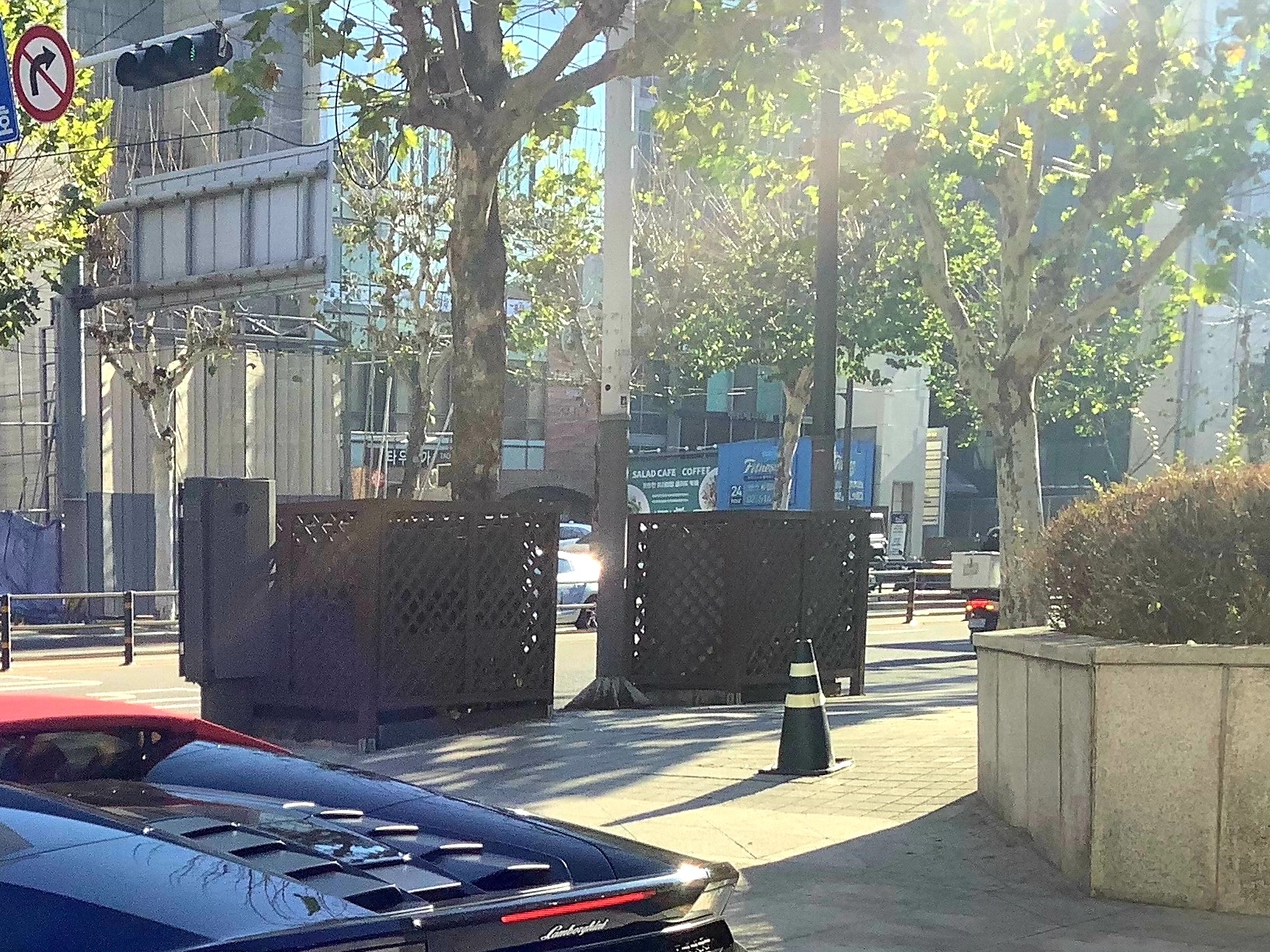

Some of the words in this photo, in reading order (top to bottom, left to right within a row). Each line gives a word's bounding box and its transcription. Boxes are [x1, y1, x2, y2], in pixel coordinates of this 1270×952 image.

[632, 469, 656, 478] SALAD
[657, 468, 677, 477] CAFE
[731, 485, 743, 497] 24
